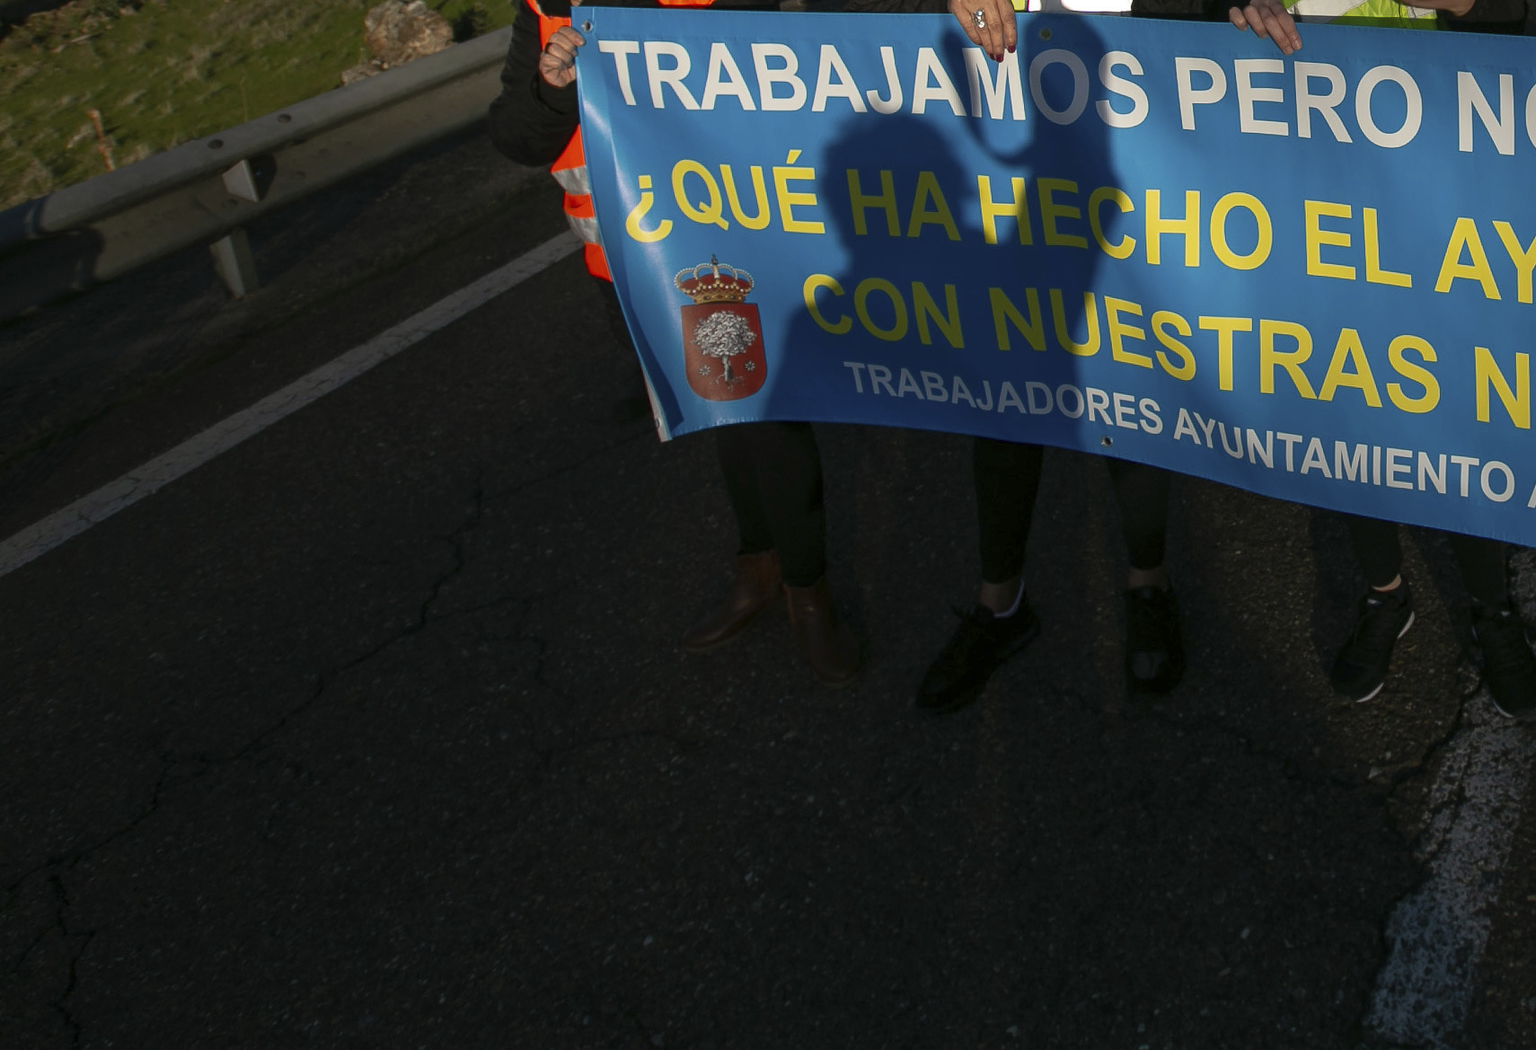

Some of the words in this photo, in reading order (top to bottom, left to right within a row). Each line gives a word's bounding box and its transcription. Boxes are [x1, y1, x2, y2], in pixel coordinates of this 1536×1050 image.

[598, 39, 1150, 128] TRABAJAMOS
[1174, 56, 1423, 149] PERO
[625, 150, 826, 243] ¿QUÉ
[846, 169, 962, 242] HA
[976, 174, 1274, 271] HECHO
[1304, 200, 1413, 289] EL
[802, 273, 965, 349] CON
[989, 287, 1441, 414] NUESTRAS
[843, 361, 1163, 435] TRABAJADORES
[1173, 406, 1516, 503] AYUNTAMIENTO
